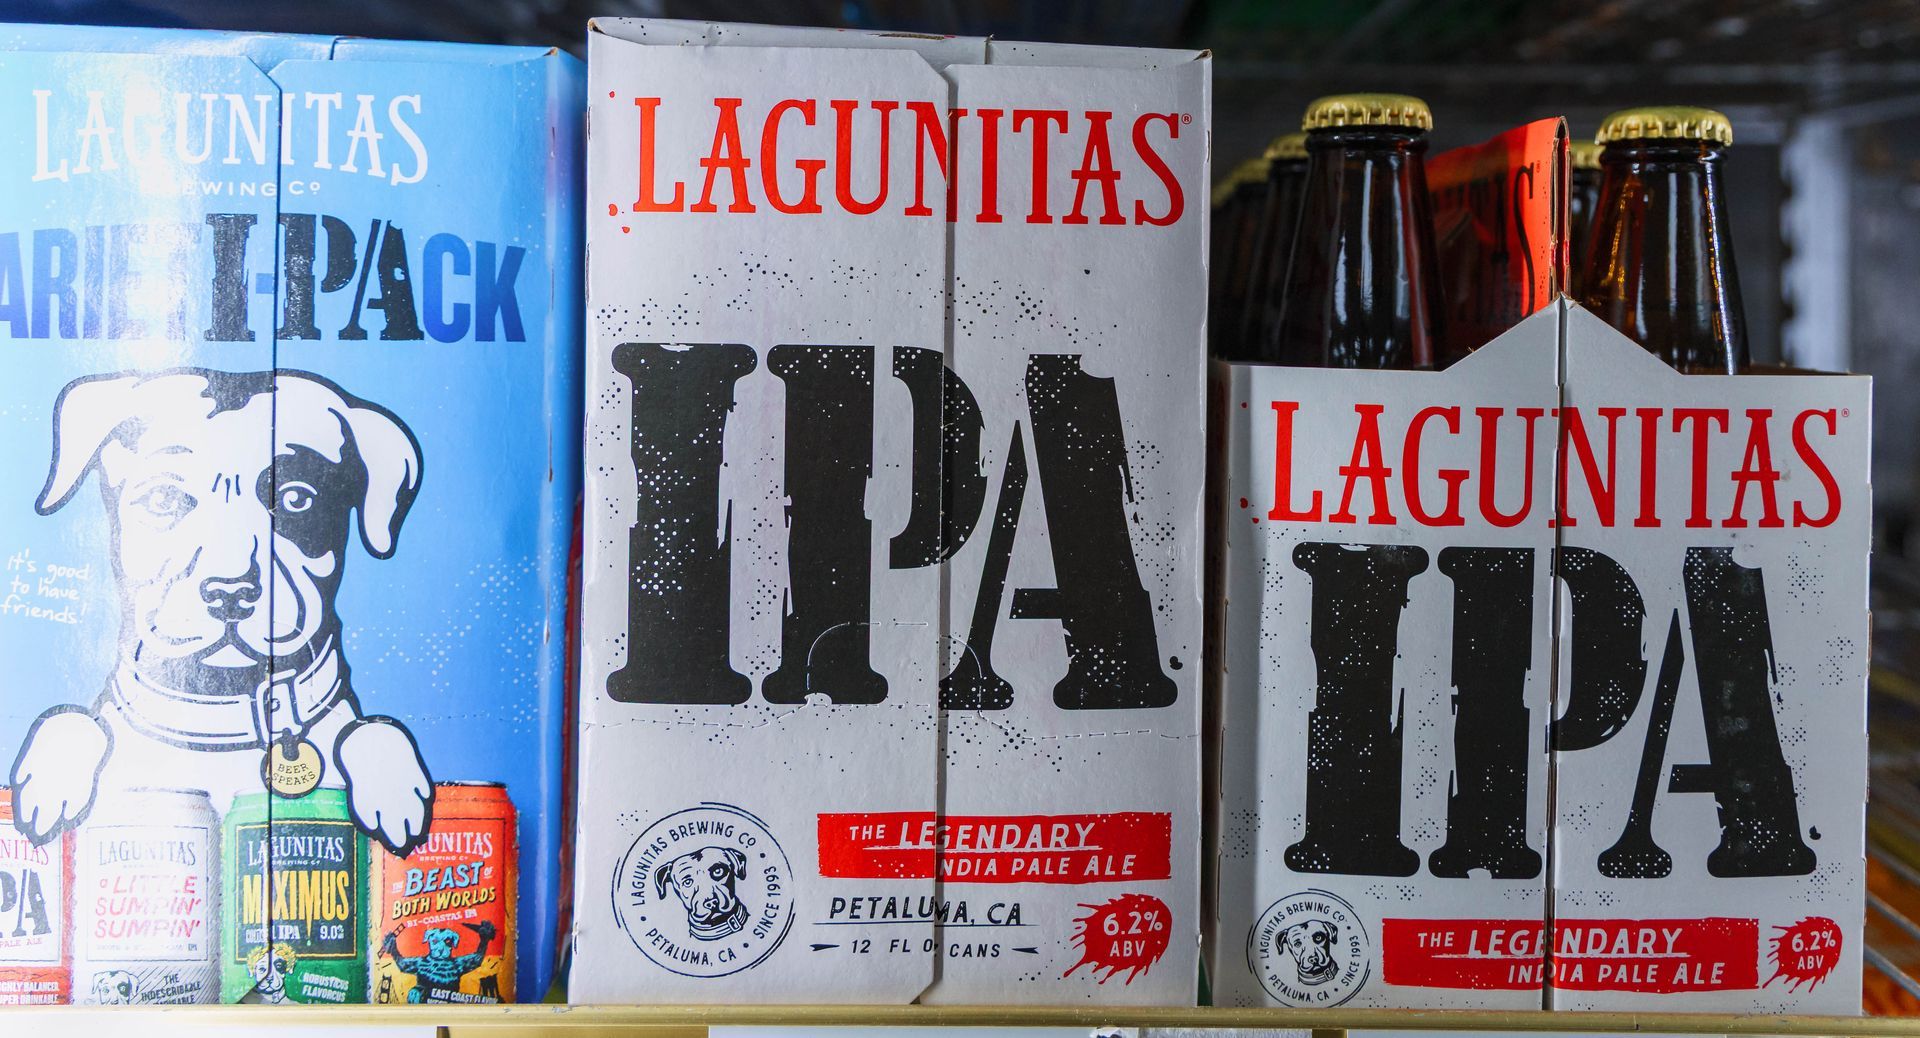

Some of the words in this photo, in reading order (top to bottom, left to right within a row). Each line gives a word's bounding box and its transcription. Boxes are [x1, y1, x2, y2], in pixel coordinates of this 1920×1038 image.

[32, 89, 430, 187] LAGUNITAS
[606, 342, 1179, 711] IPA
[46, 563, 91, 585] good
[11, 573, 31, 595] to
[37, 576, 81, 600] have
[0, 594, 88, 625] friends!
[1283, 541, 1818, 880] IPA
[277, 763, 309, 774] BEER
[849, 824, 887, 842] THE
[899, 820, 1097, 851] LEGENDARY
[99, 840, 197, 866] LAGUNITAS
[631, 837, 668, 906] LAGUNITAS
[669, 821, 735, 842] BREWING
[938, 858, 999, 877] NDIA
[1010, 857, 1071, 876] PALE
[1083, 854, 1137, 876] ALE
[404, 861, 485, 898] BEAST
[763, 865, 781, 897] 1993
[392, 896, 431, 920] BOTH
[436, 886, 497, 912] WORLDS
[986, 902, 1022, 926] CA
[277, 925, 301, 940] IPA
[752, 902, 780, 940] SINCE
[1103, 910, 1163, 936] 6.2%
[1260, 911, 1286, 959] LAGUNITAS
[1286, 901, 1330, 916] BREWING
[851, 939, 871, 954] 12
[889, 939, 911, 953] FL
[949, 943, 1001, 958] CANS
[1109, 940, 1146, 957] ABV
[1349, 935, 1361, 957] 1993
[1417, 931, 1455, 948] THE
[1791, 929, 1837, 953] 6.2%
[718, 947, 737, 963] CA
[1796, 954, 1825, 971] ABV
[164, 973, 180, 985] THE
[1340, 960, 1360, 987] SINCE
[1507, 962, 1584, 984] INDIA
[1597, 964, 1660, 983] PALE
[1671, 962, 1726, 985] ALE
[431, 987, 451, 999] EAST
[450, 991, 474, 1003] COAST
[1317, 990, 1330, 1001] CA
